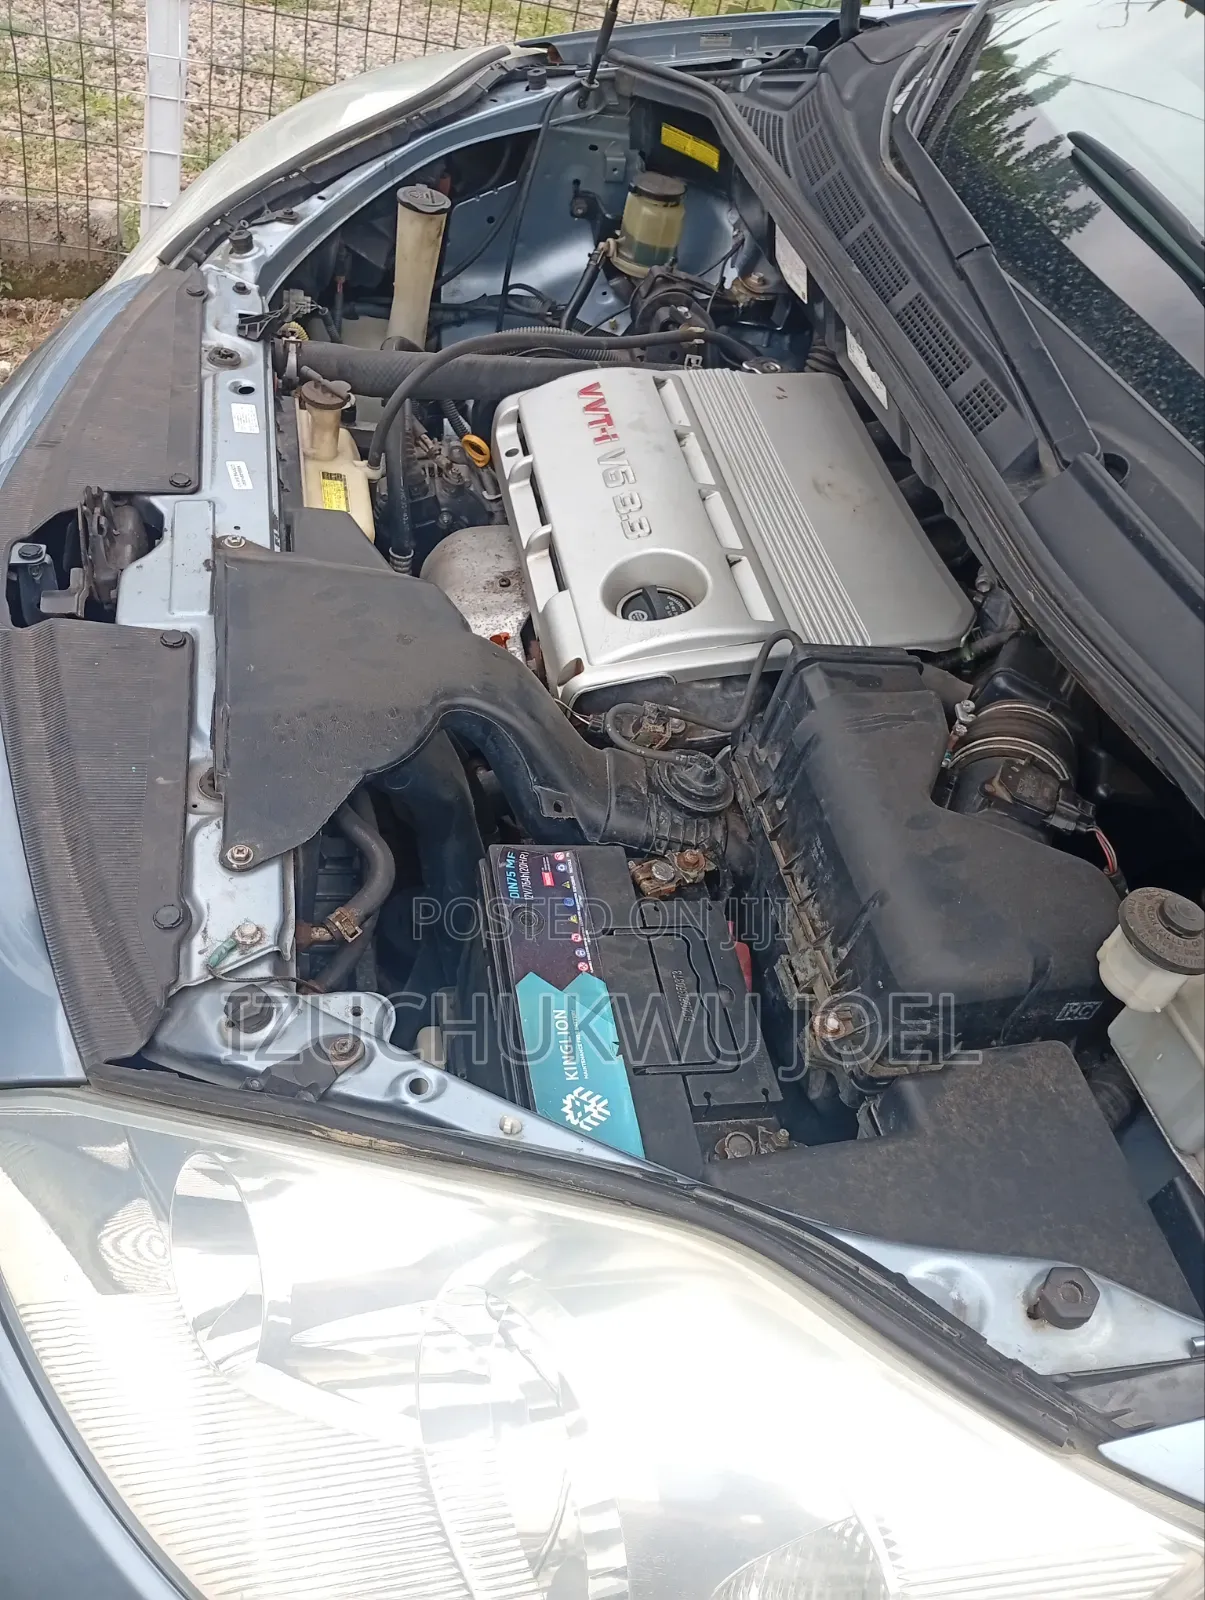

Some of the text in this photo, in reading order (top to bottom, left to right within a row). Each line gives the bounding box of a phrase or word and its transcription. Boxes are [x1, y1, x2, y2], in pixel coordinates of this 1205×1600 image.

[577, 382, 652, 540] VVT-i V6 3.3
[505, 851, 520, 899] DIN75 MF
[552, 1010, 579, 1081] KINGLION
